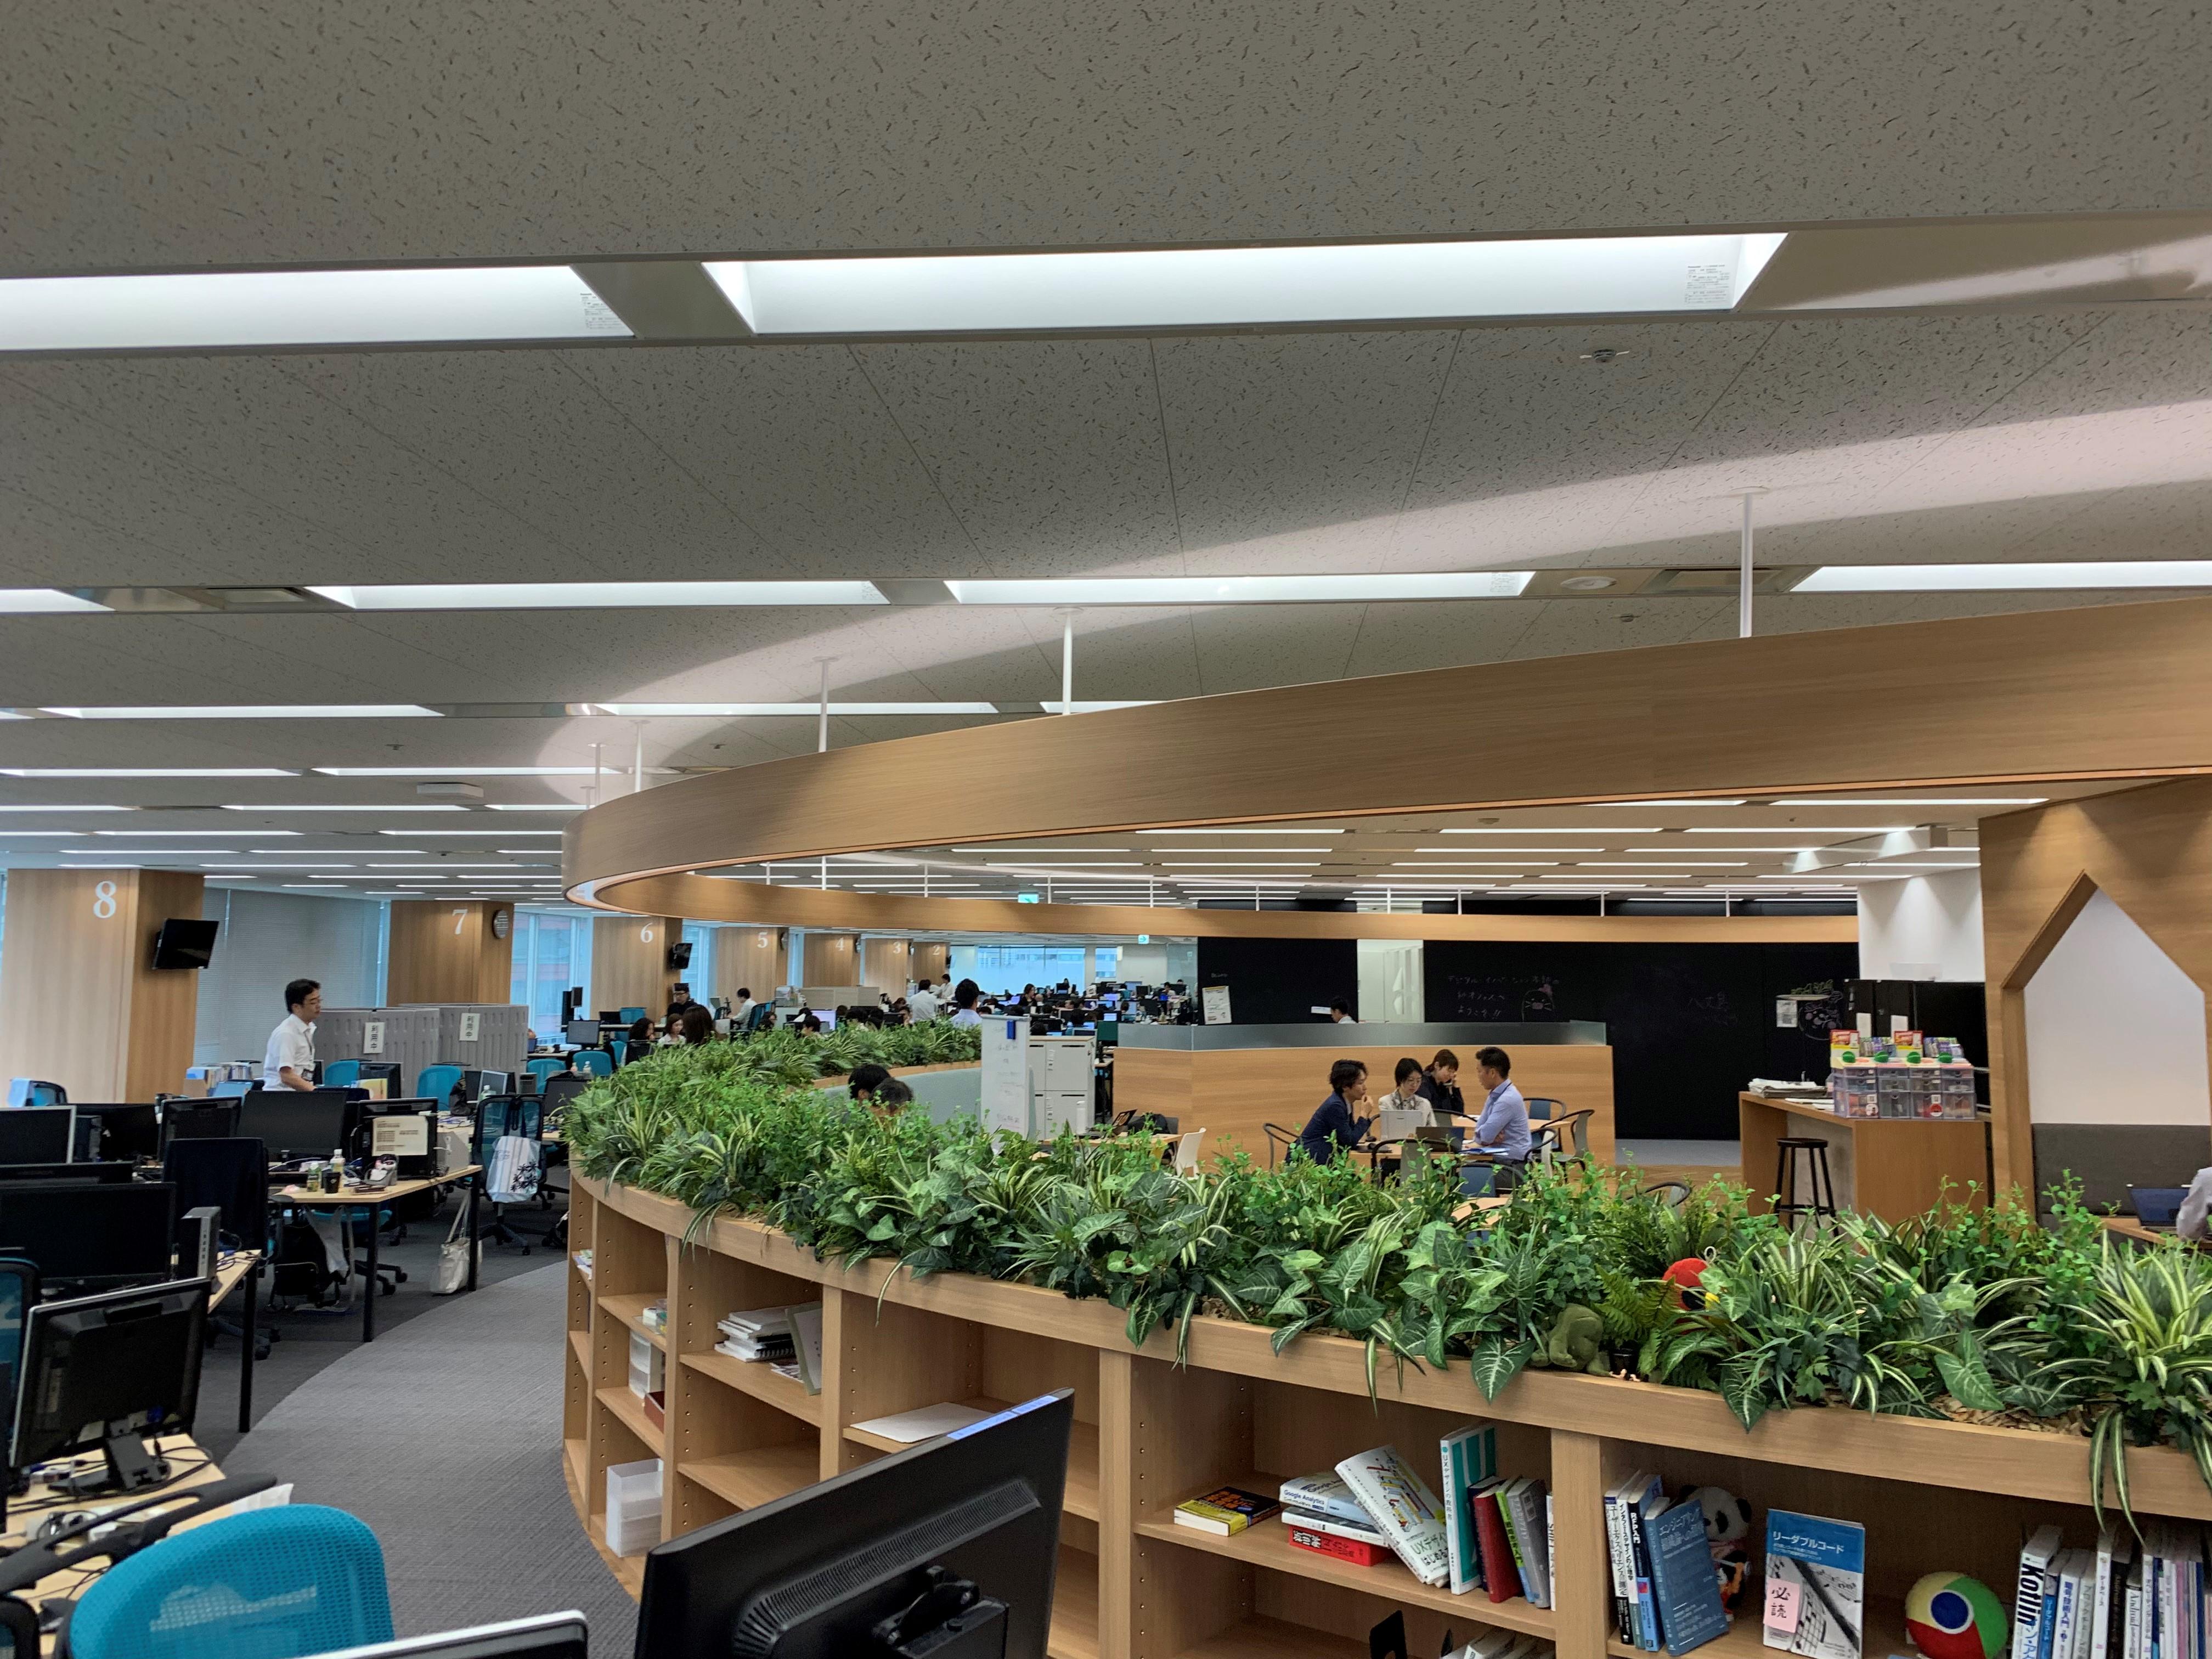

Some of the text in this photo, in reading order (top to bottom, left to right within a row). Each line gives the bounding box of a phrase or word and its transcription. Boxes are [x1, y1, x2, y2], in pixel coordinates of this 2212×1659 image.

[93, 881, 116, 918] 8
[452, 909, 468, 935] 7
[640, 923, 653, 943] 6
[757, 932, 768, 948] 5
[835, 938, 844, 951] 4
[893, 941, 901, 953] 3
[933, 945, 940, 955] 2
[1284, 1489, 1301, 1499] Google
[1302, 1495, 1324, 1505] Analytics
[1773, 1531, 1844, 1554] リーダブルコード
[1770, 1587, 1791, 1618] 必読
[2017, 1564, 2044, 1626] Kotlin
